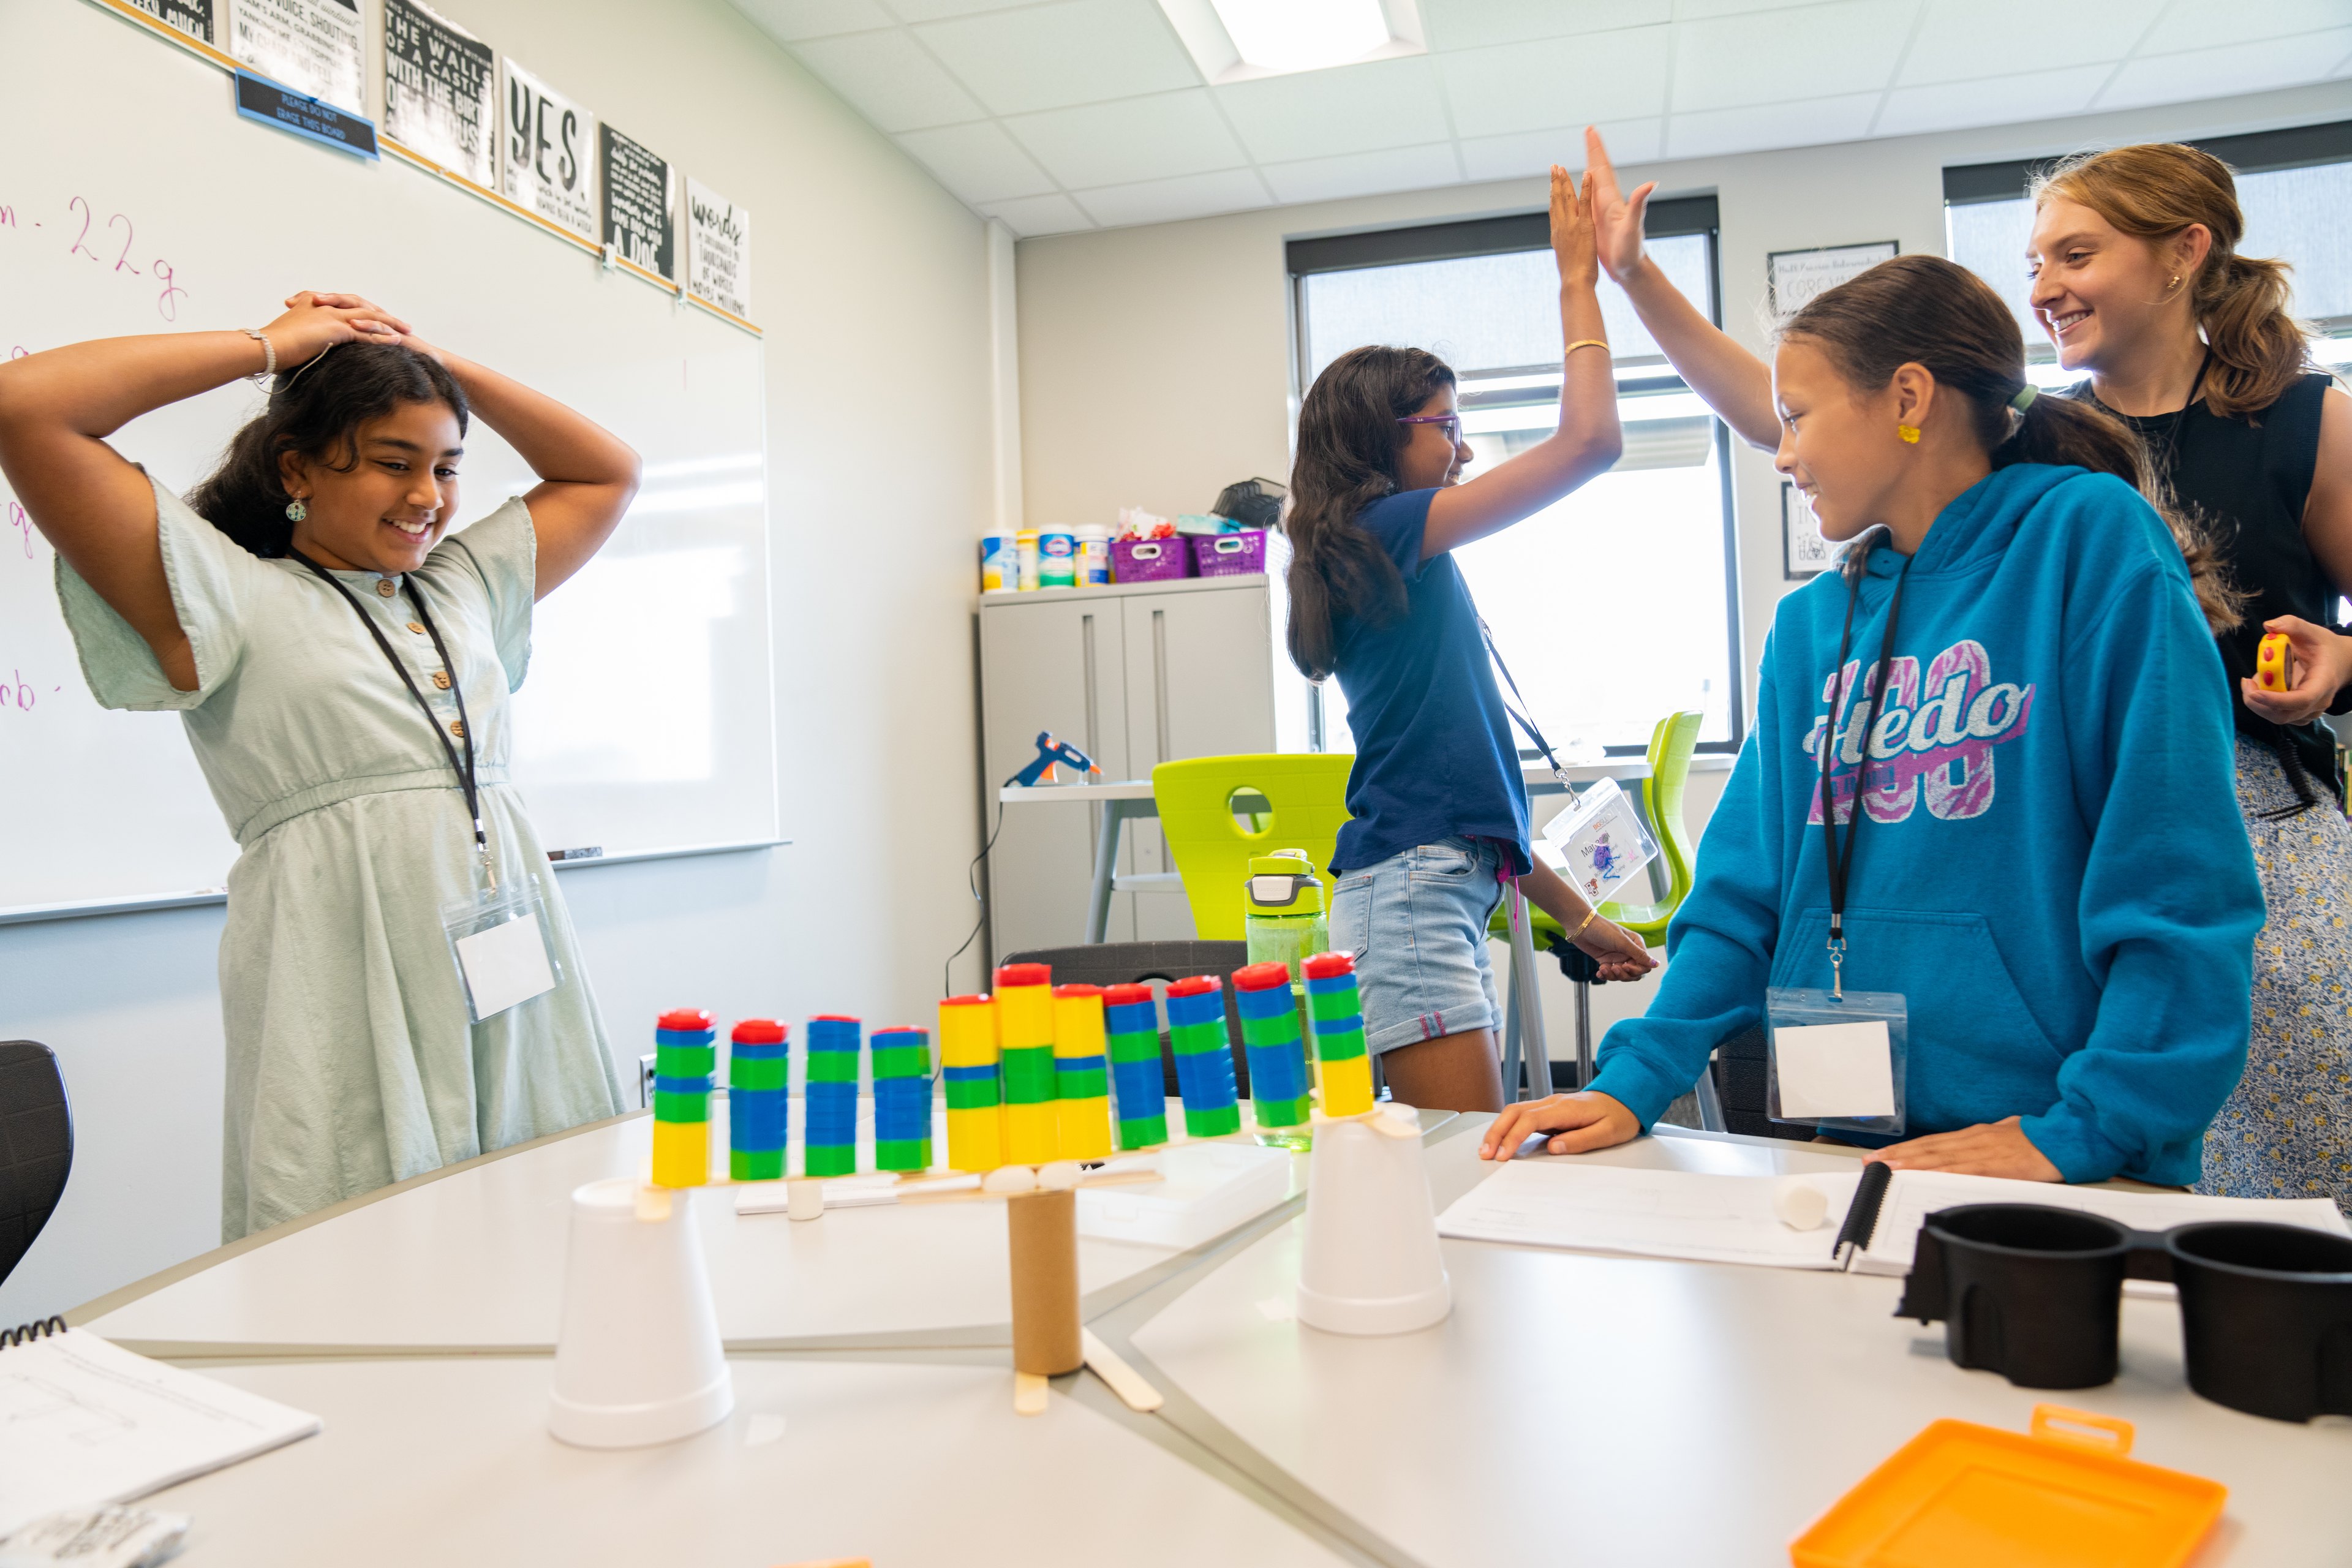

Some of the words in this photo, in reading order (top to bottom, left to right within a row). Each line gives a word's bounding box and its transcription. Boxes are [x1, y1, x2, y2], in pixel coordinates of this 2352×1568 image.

[385, 8, 420, 46] THE
[428, 36, 492, 87] WALLS
[385, 31, 405, 53] OF
[412, 48, 424, 66] A
[386, 48, 423, 92] WITH
[424, 72, 452, 109] THE
[1802, 669, 2032, 773] Hedo
